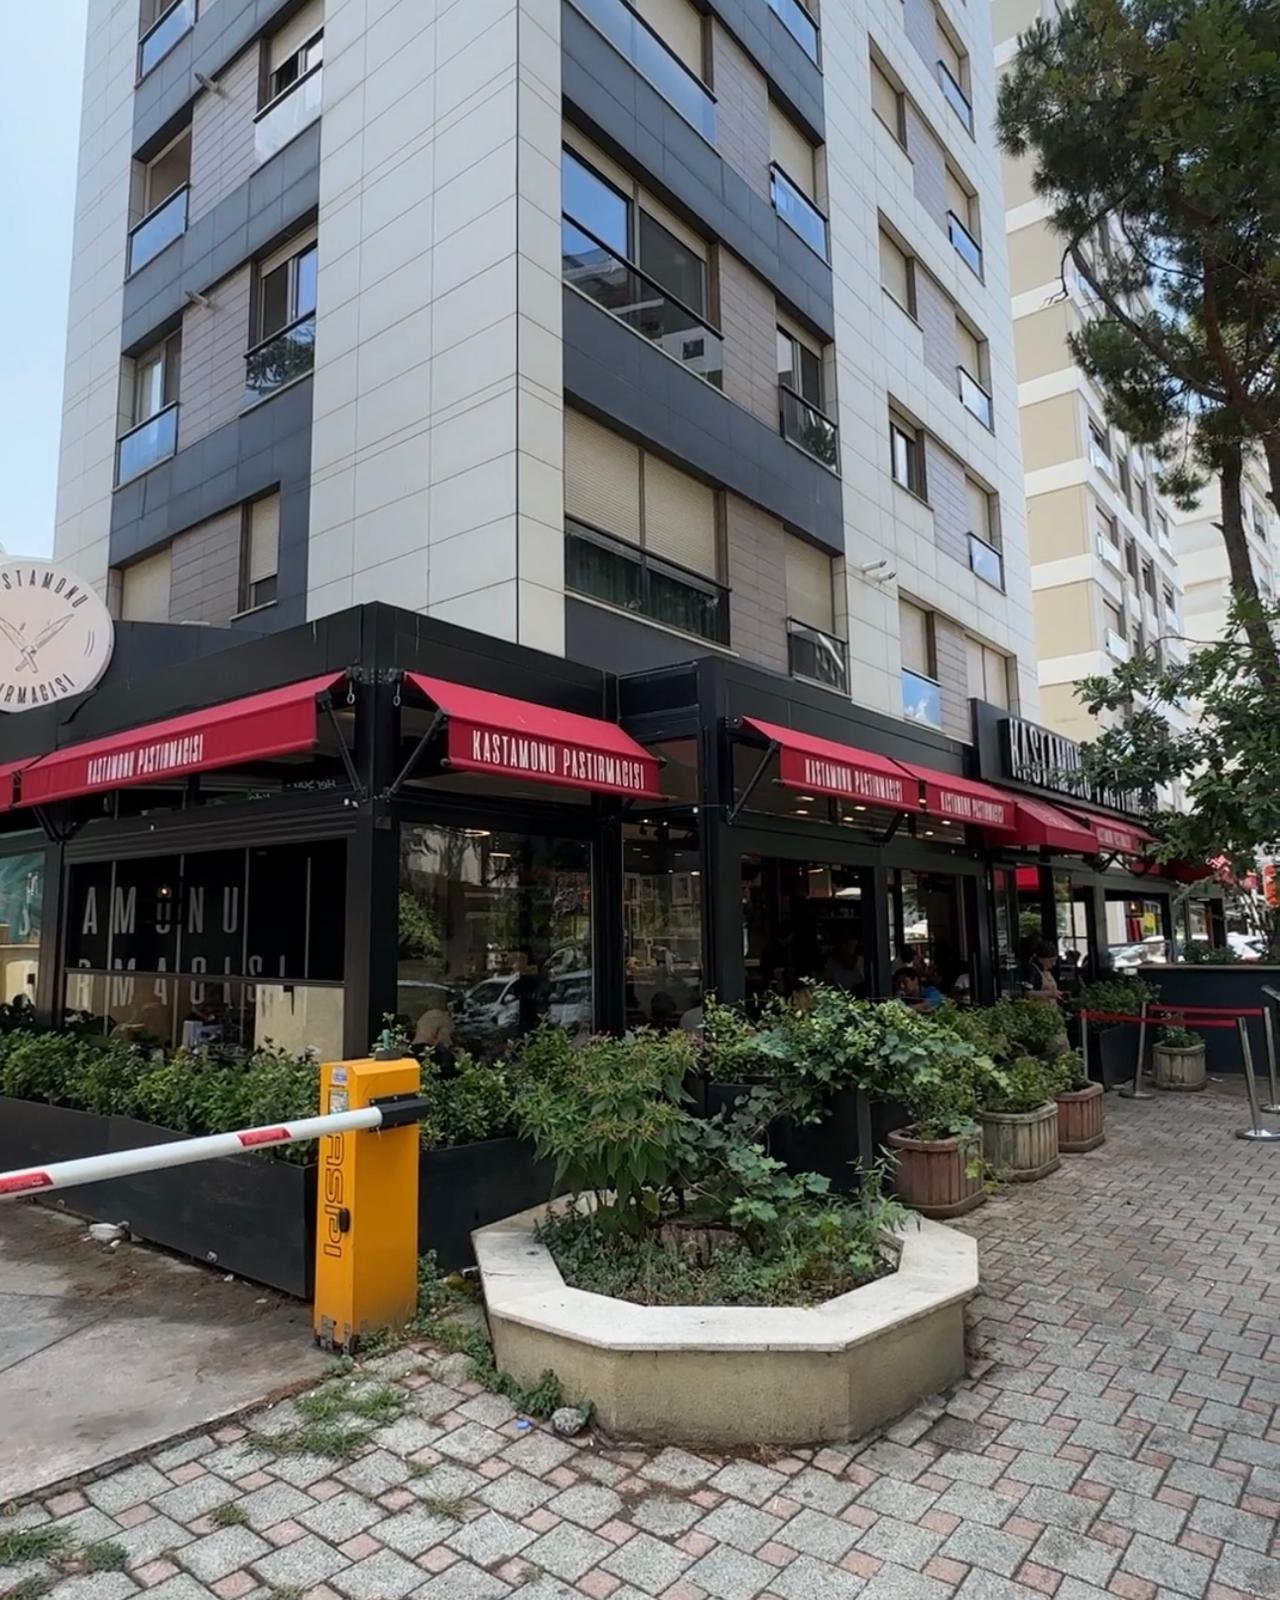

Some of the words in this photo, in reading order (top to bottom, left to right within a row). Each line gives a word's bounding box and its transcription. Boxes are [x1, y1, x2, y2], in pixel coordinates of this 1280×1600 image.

[87, 750, 136, 785] KASTAMONU
[472, 729, 556, 774] KASTAMONU
[563, 747, 645, 790] PASTIRMACISI
